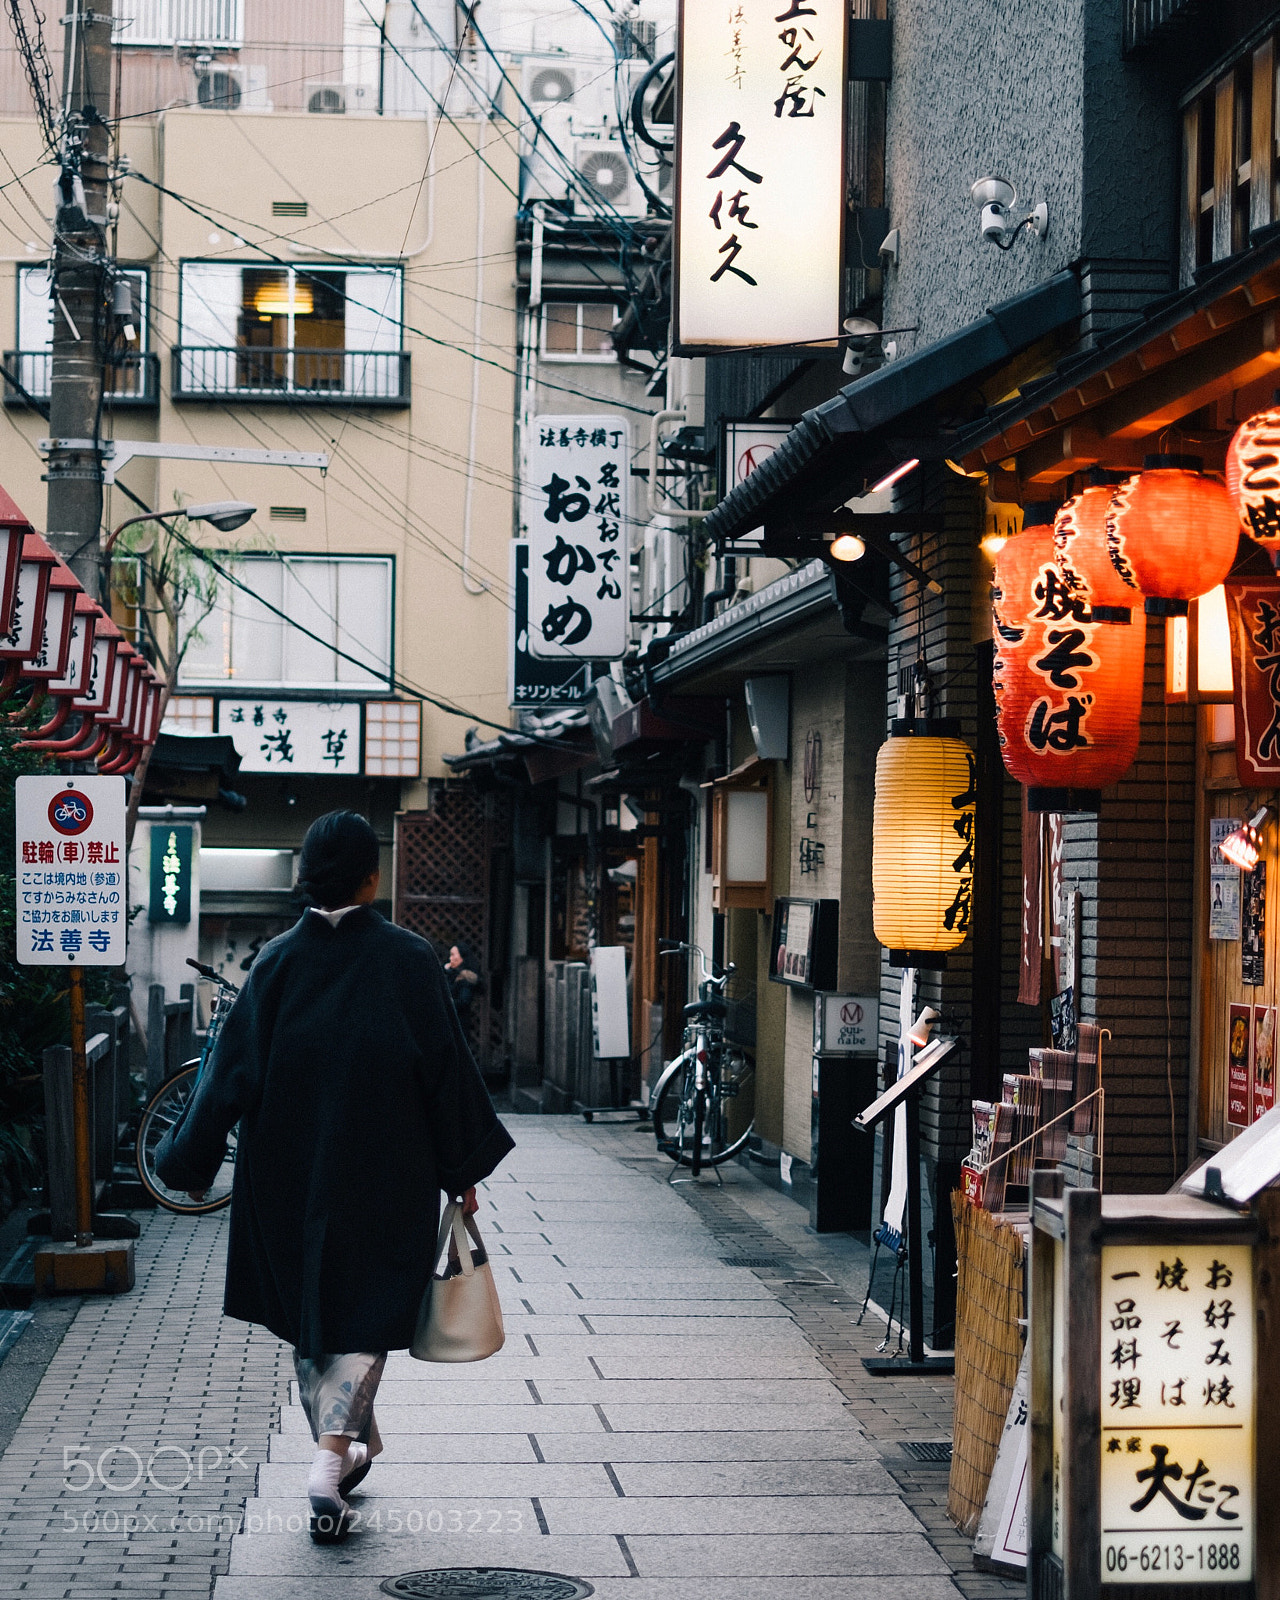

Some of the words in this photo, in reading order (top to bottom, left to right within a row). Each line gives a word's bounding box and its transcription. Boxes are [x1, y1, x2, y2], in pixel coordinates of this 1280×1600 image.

[706, 121, 764, 287] 久佐久
[539, 427, 623, 449] 法善寺横丁
[594, 461, 622, 600] 名代おでん
[541, 472, 597, 646] おかめ
[1028, 568, 1094, 750] 焼そば
[515, 684, 582, 699] キリンビール
[22, 841, 120, 864] 駐輪（車）禁止
[22, 872, 121, 886] ここは境内地（参道）
[22, 891, 120, 904] ですからみなさんの
[22, 910, 120, 923] ご協力をお願いします
[31, 928, 111, 952] 法善寺
[1110, 1271, 1142, 1410] 一品料理
[1155, 1257, 1189, 1407] 焼そば
[1203, 1259, 1236, 1409] お好み焼
[1107, 1437, 1142, 1453] 本家
[1130, 1444, 1240, 1521] 大たこ
[1106, 1543, 1240, 1572] 06-6213-1888
